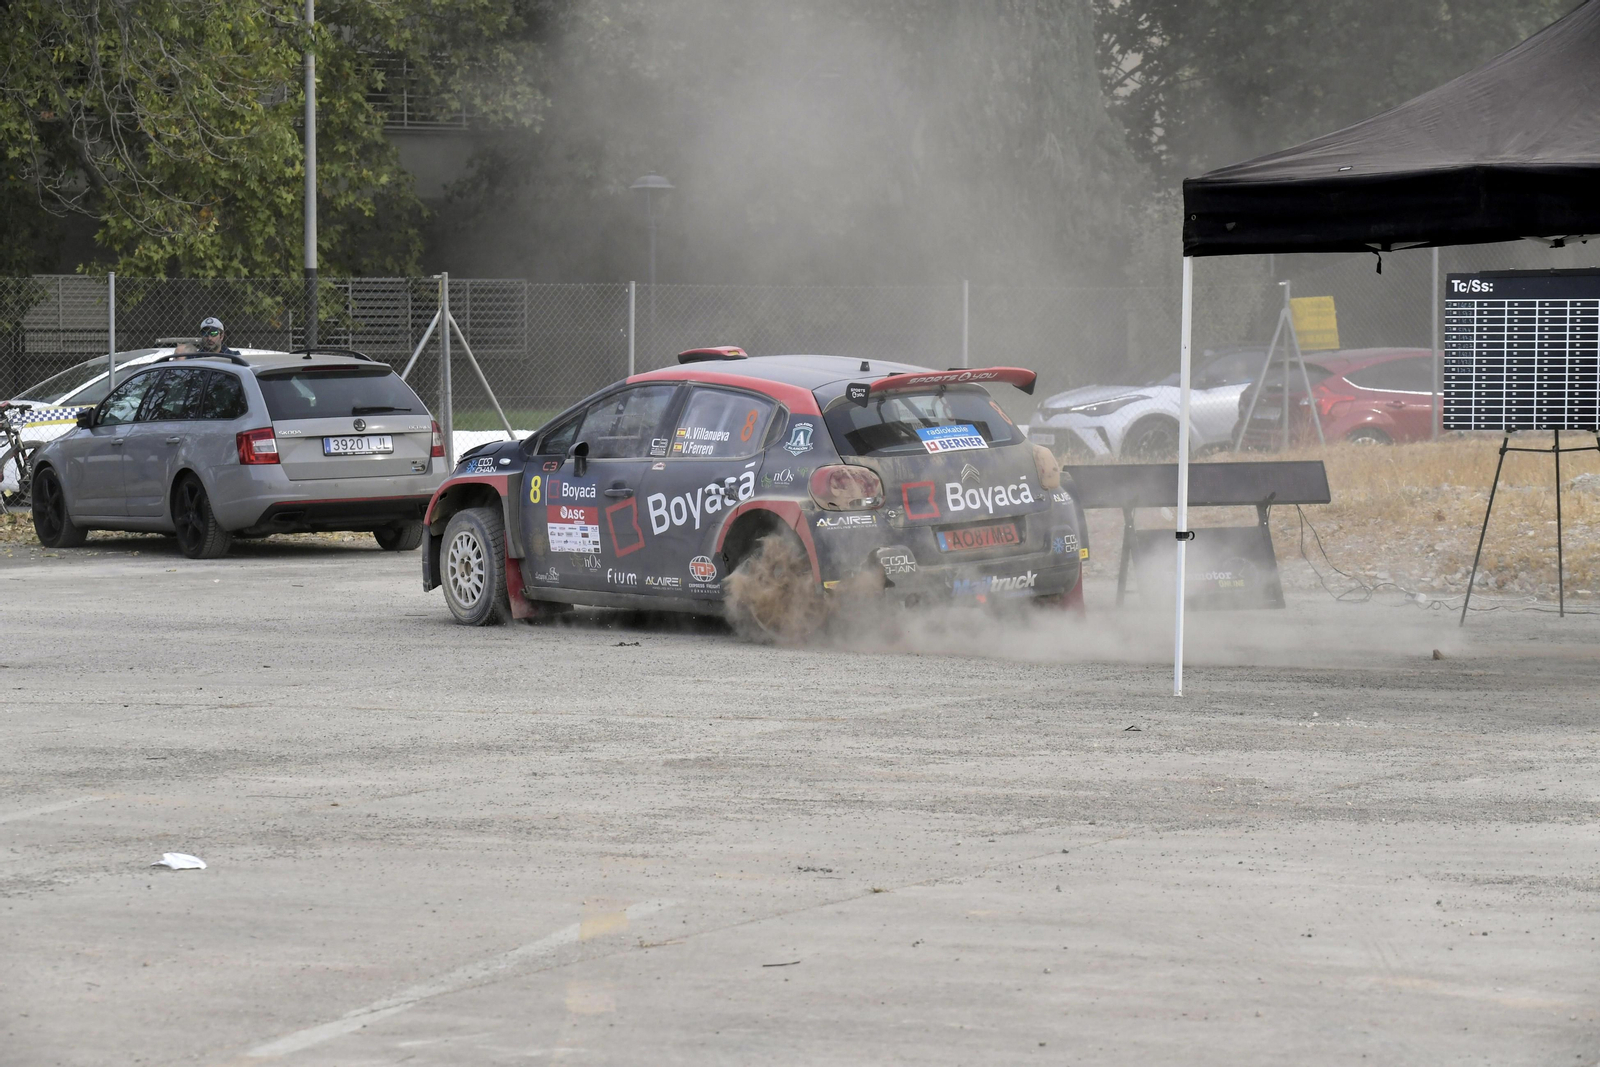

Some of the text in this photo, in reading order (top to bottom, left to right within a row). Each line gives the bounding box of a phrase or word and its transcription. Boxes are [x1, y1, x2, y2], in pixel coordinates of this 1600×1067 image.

[1451, 279, 1494, 293] Tc/Ss:
[908, 374, 957, 384] SPORTS
[988, 401, 1012, 425] 8
[741, 409, 758, 442] 8
[926, 426, 969, 435] radiokable
[333, 438, 364, 451] 3920
[651, 438, 668, 448] C3
[682, 441, 714, 455] V.Ferrero
[937, 437, 985, 450] BERNER
[543, 461, 558, 471] C3
[529, 475, 541, 503] 8
[562, 482, 596, 500] Boyacá
[945, 475, 1035, 514] Boyacá
[646, 461, 755, 536] Boyacá
[567, 509, 585, 520] ASC
[880, 555, 916, 566] COOL
[690, 562, 715, 576] TOP
